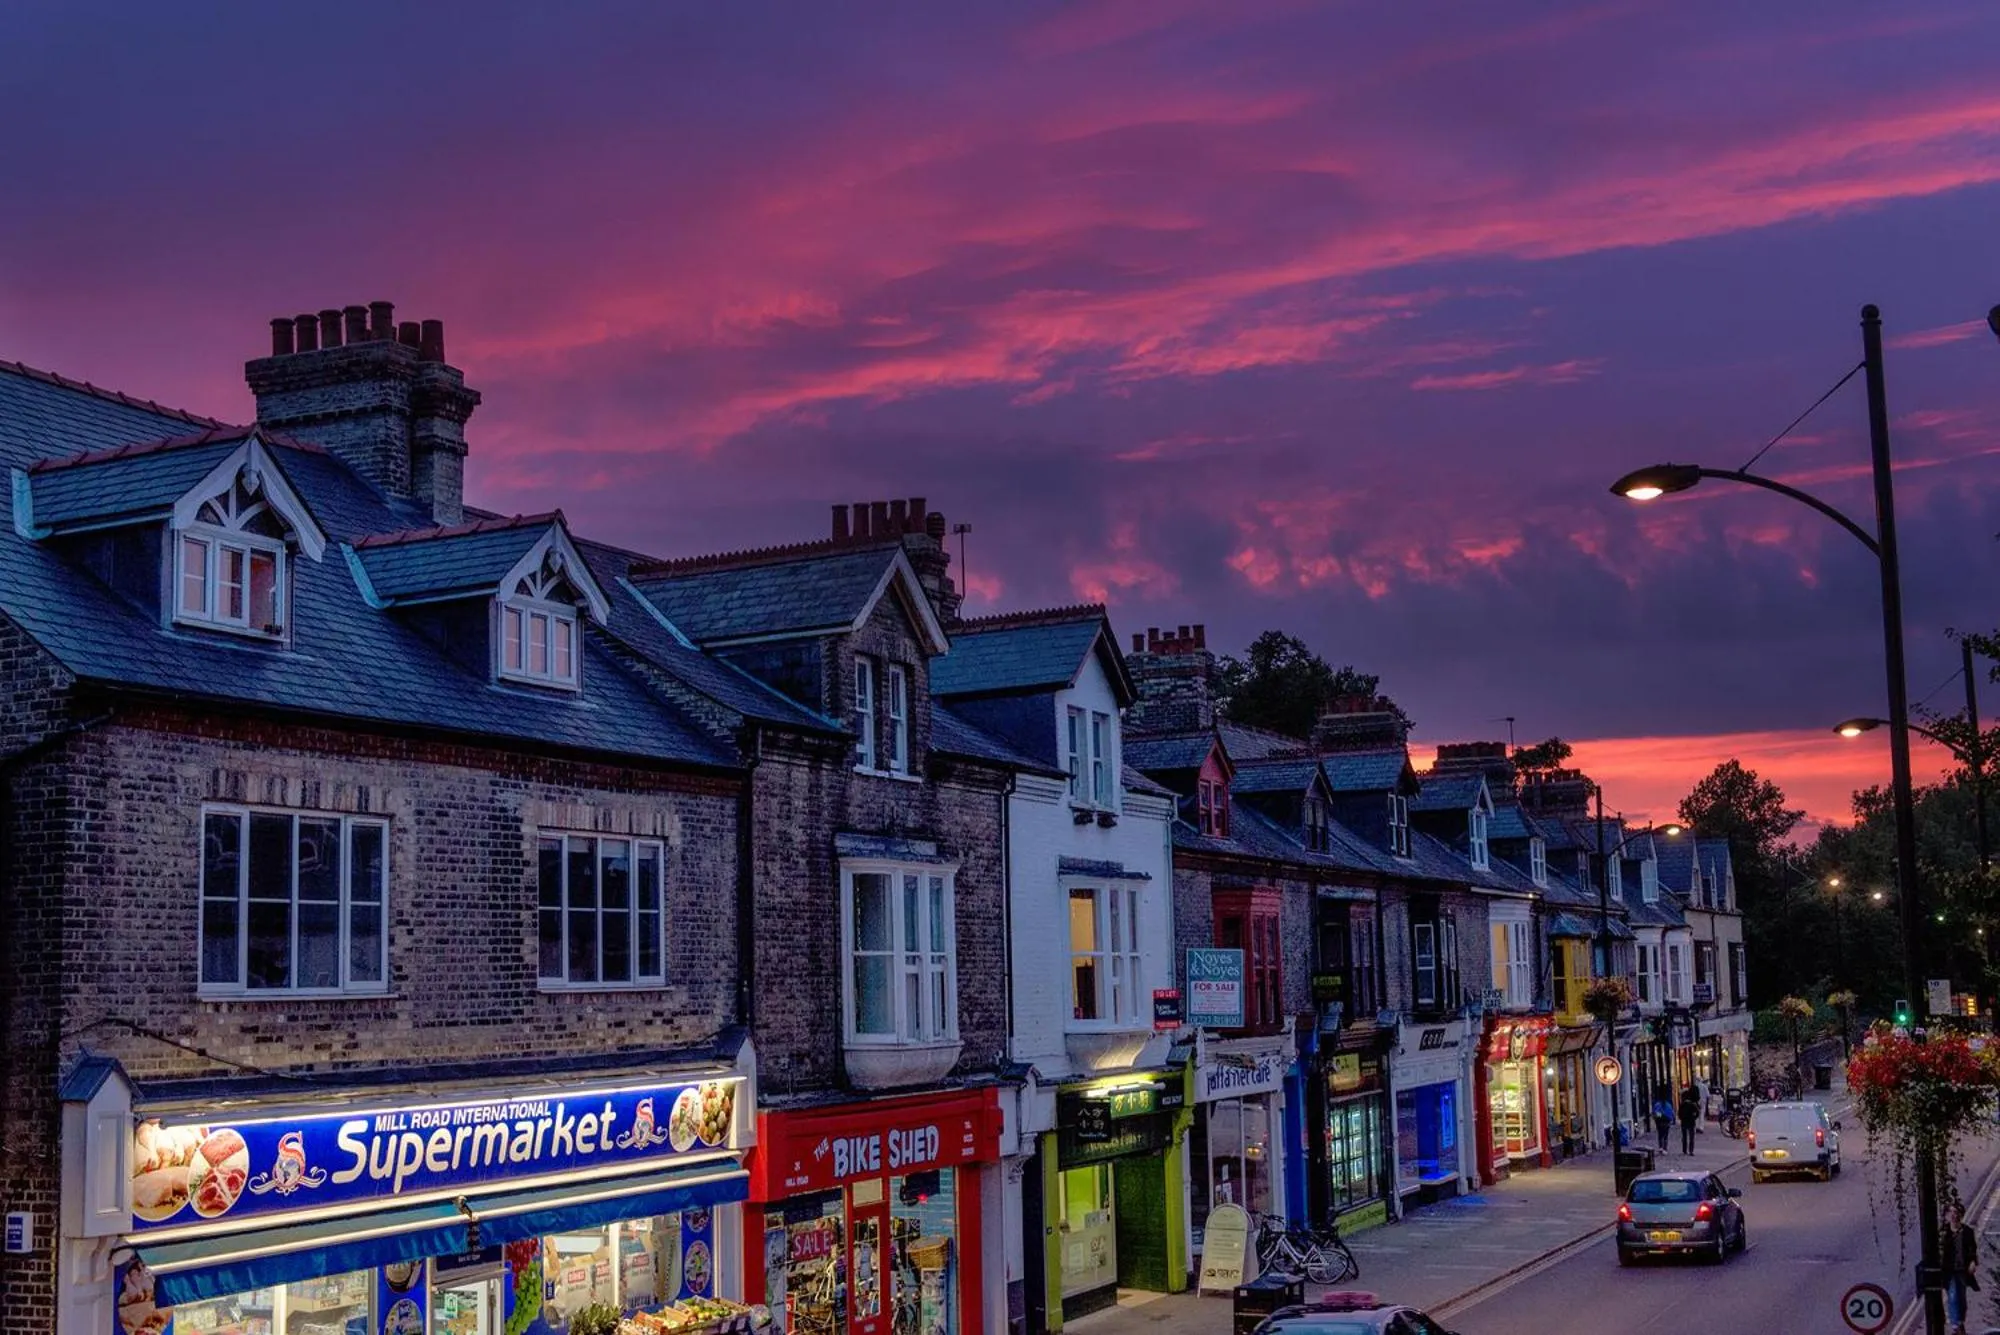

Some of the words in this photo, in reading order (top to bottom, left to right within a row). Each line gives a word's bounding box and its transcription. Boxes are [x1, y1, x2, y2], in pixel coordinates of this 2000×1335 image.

[1193, 950, 1233, 966] Noyes
[1190, 963, 1200, 976] &
[1202, 963, 1240, 979] Noyes
[1194, 982, 1213, 991] FOR
[1215, 982, 1235, 991] SALE
[375, 1115, 406, 1132] MILL
[411, 1110, 450, 1128] ROAD
[452, 1101, 552, 1125] INTERNATIONAL
[331, 1101, 617, 1194] Supermarket
[813, 1136, 829, 1161] THE
[832, 1134, 881, 1178] BIKE
[887, 1125, 940, 1170] SHED
[794, 1230, 831, 1256] SALE
[1850, 1299, 1883, 1318] 20
